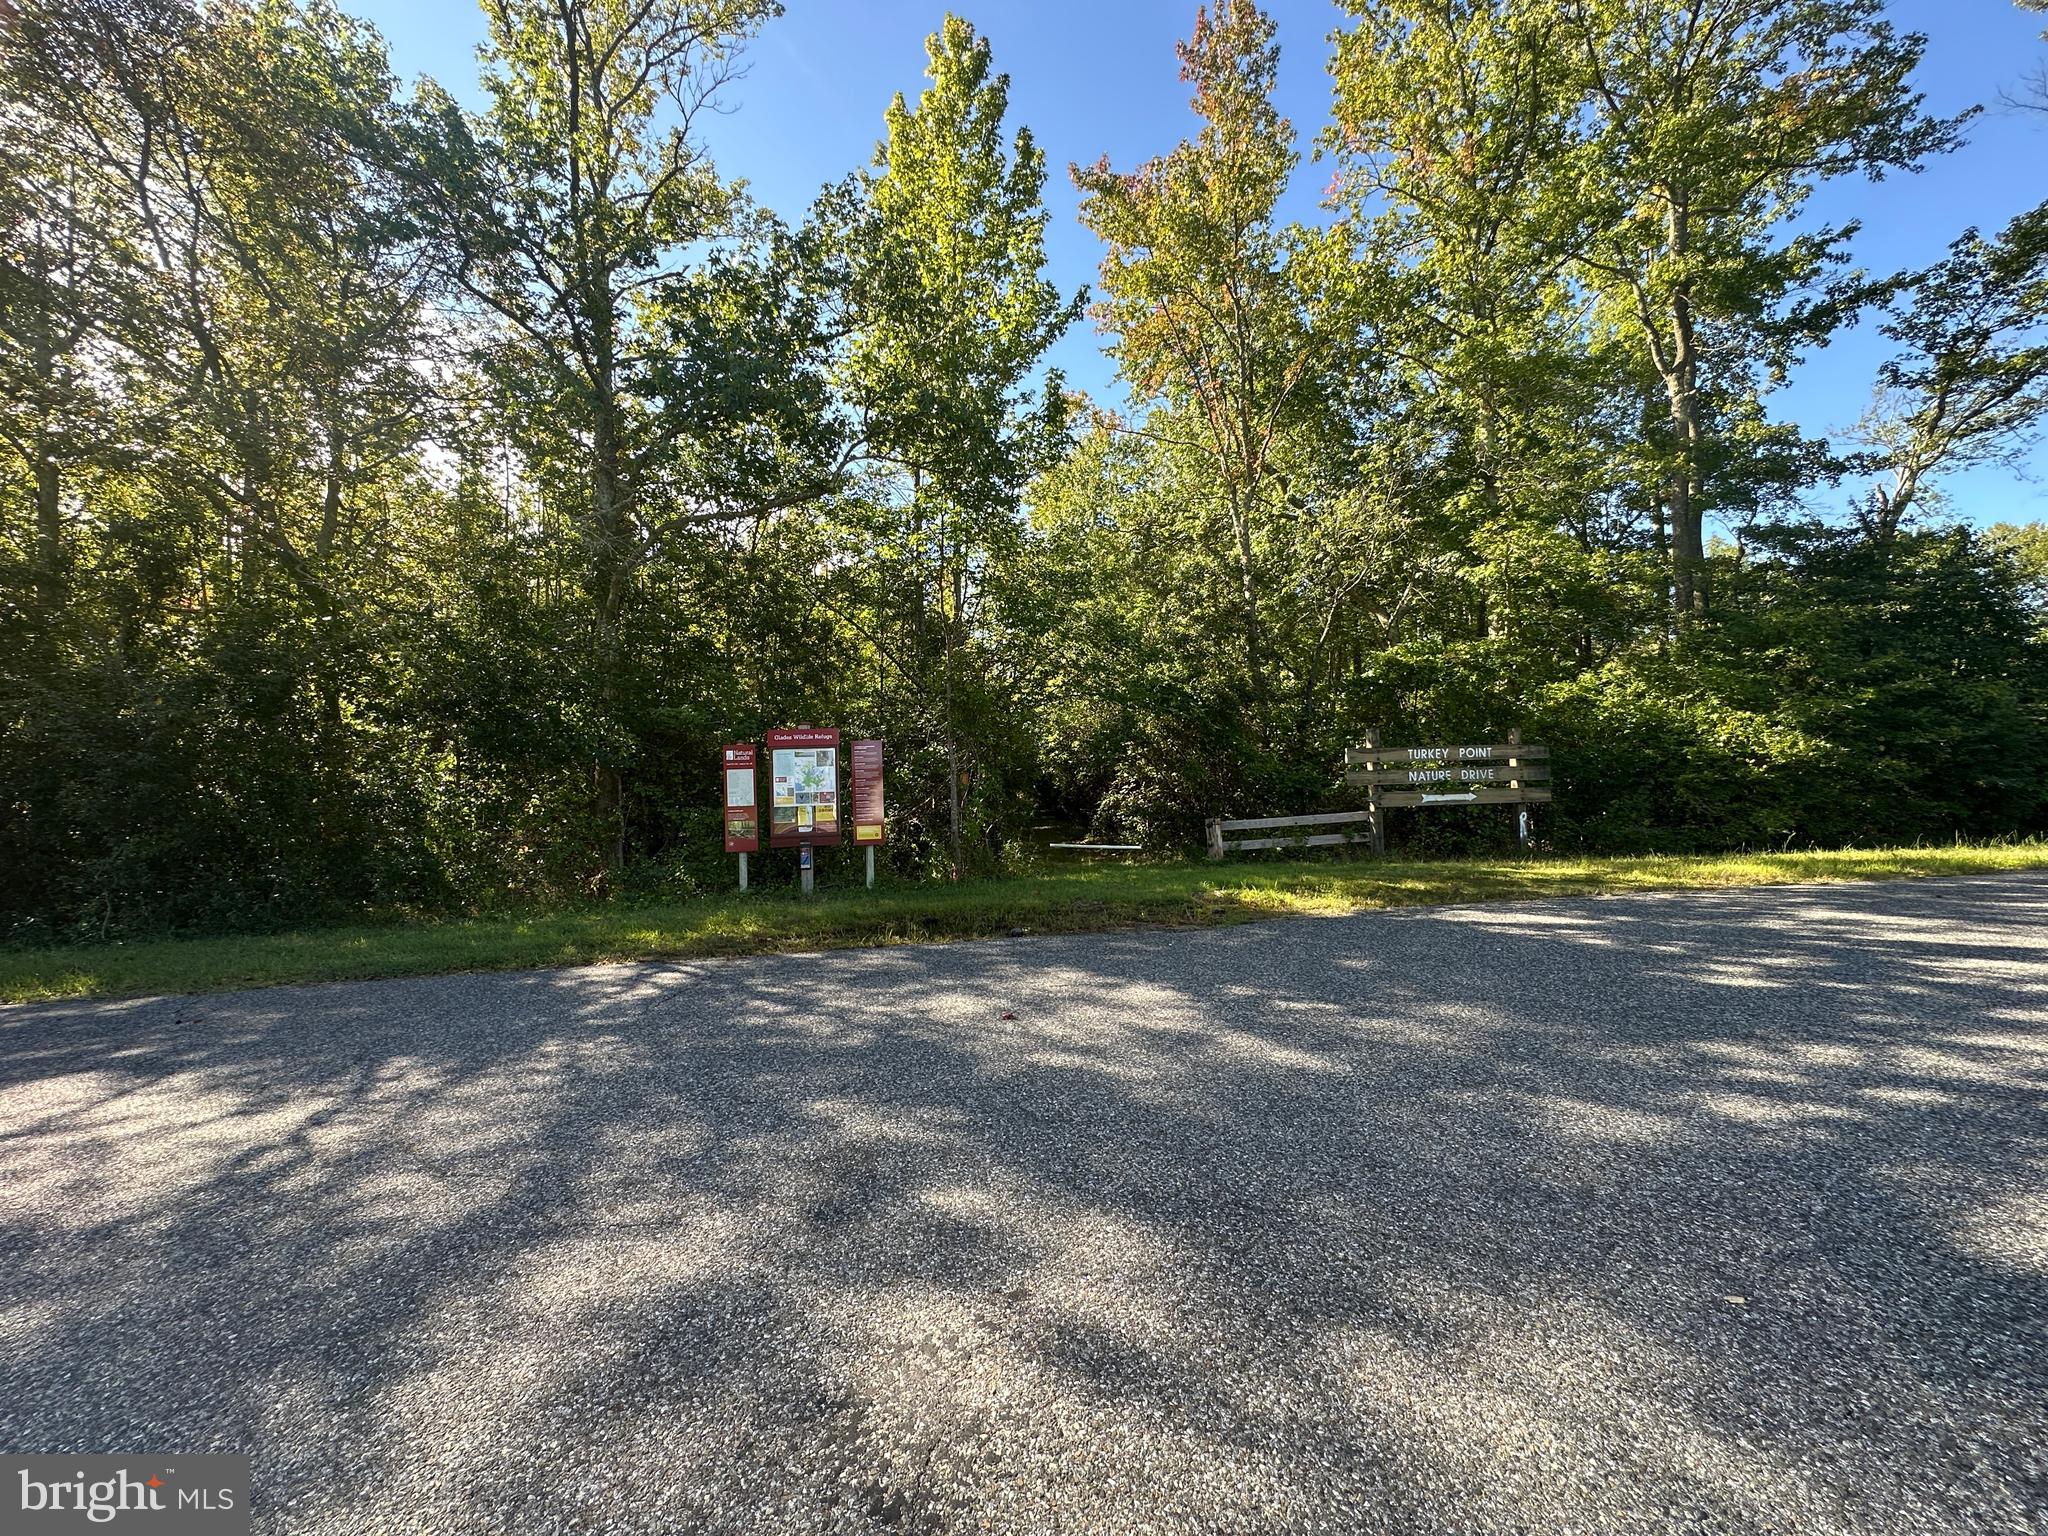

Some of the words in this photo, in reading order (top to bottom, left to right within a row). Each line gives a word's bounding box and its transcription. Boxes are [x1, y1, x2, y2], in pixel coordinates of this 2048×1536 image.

[1408, 748, 1449, 760] TURKEY
[1459, 747, 1492, 758] POINT
[1408, 770, 1451, 782] NATURE
[1461, 769, 1494, 780] DRIVE
